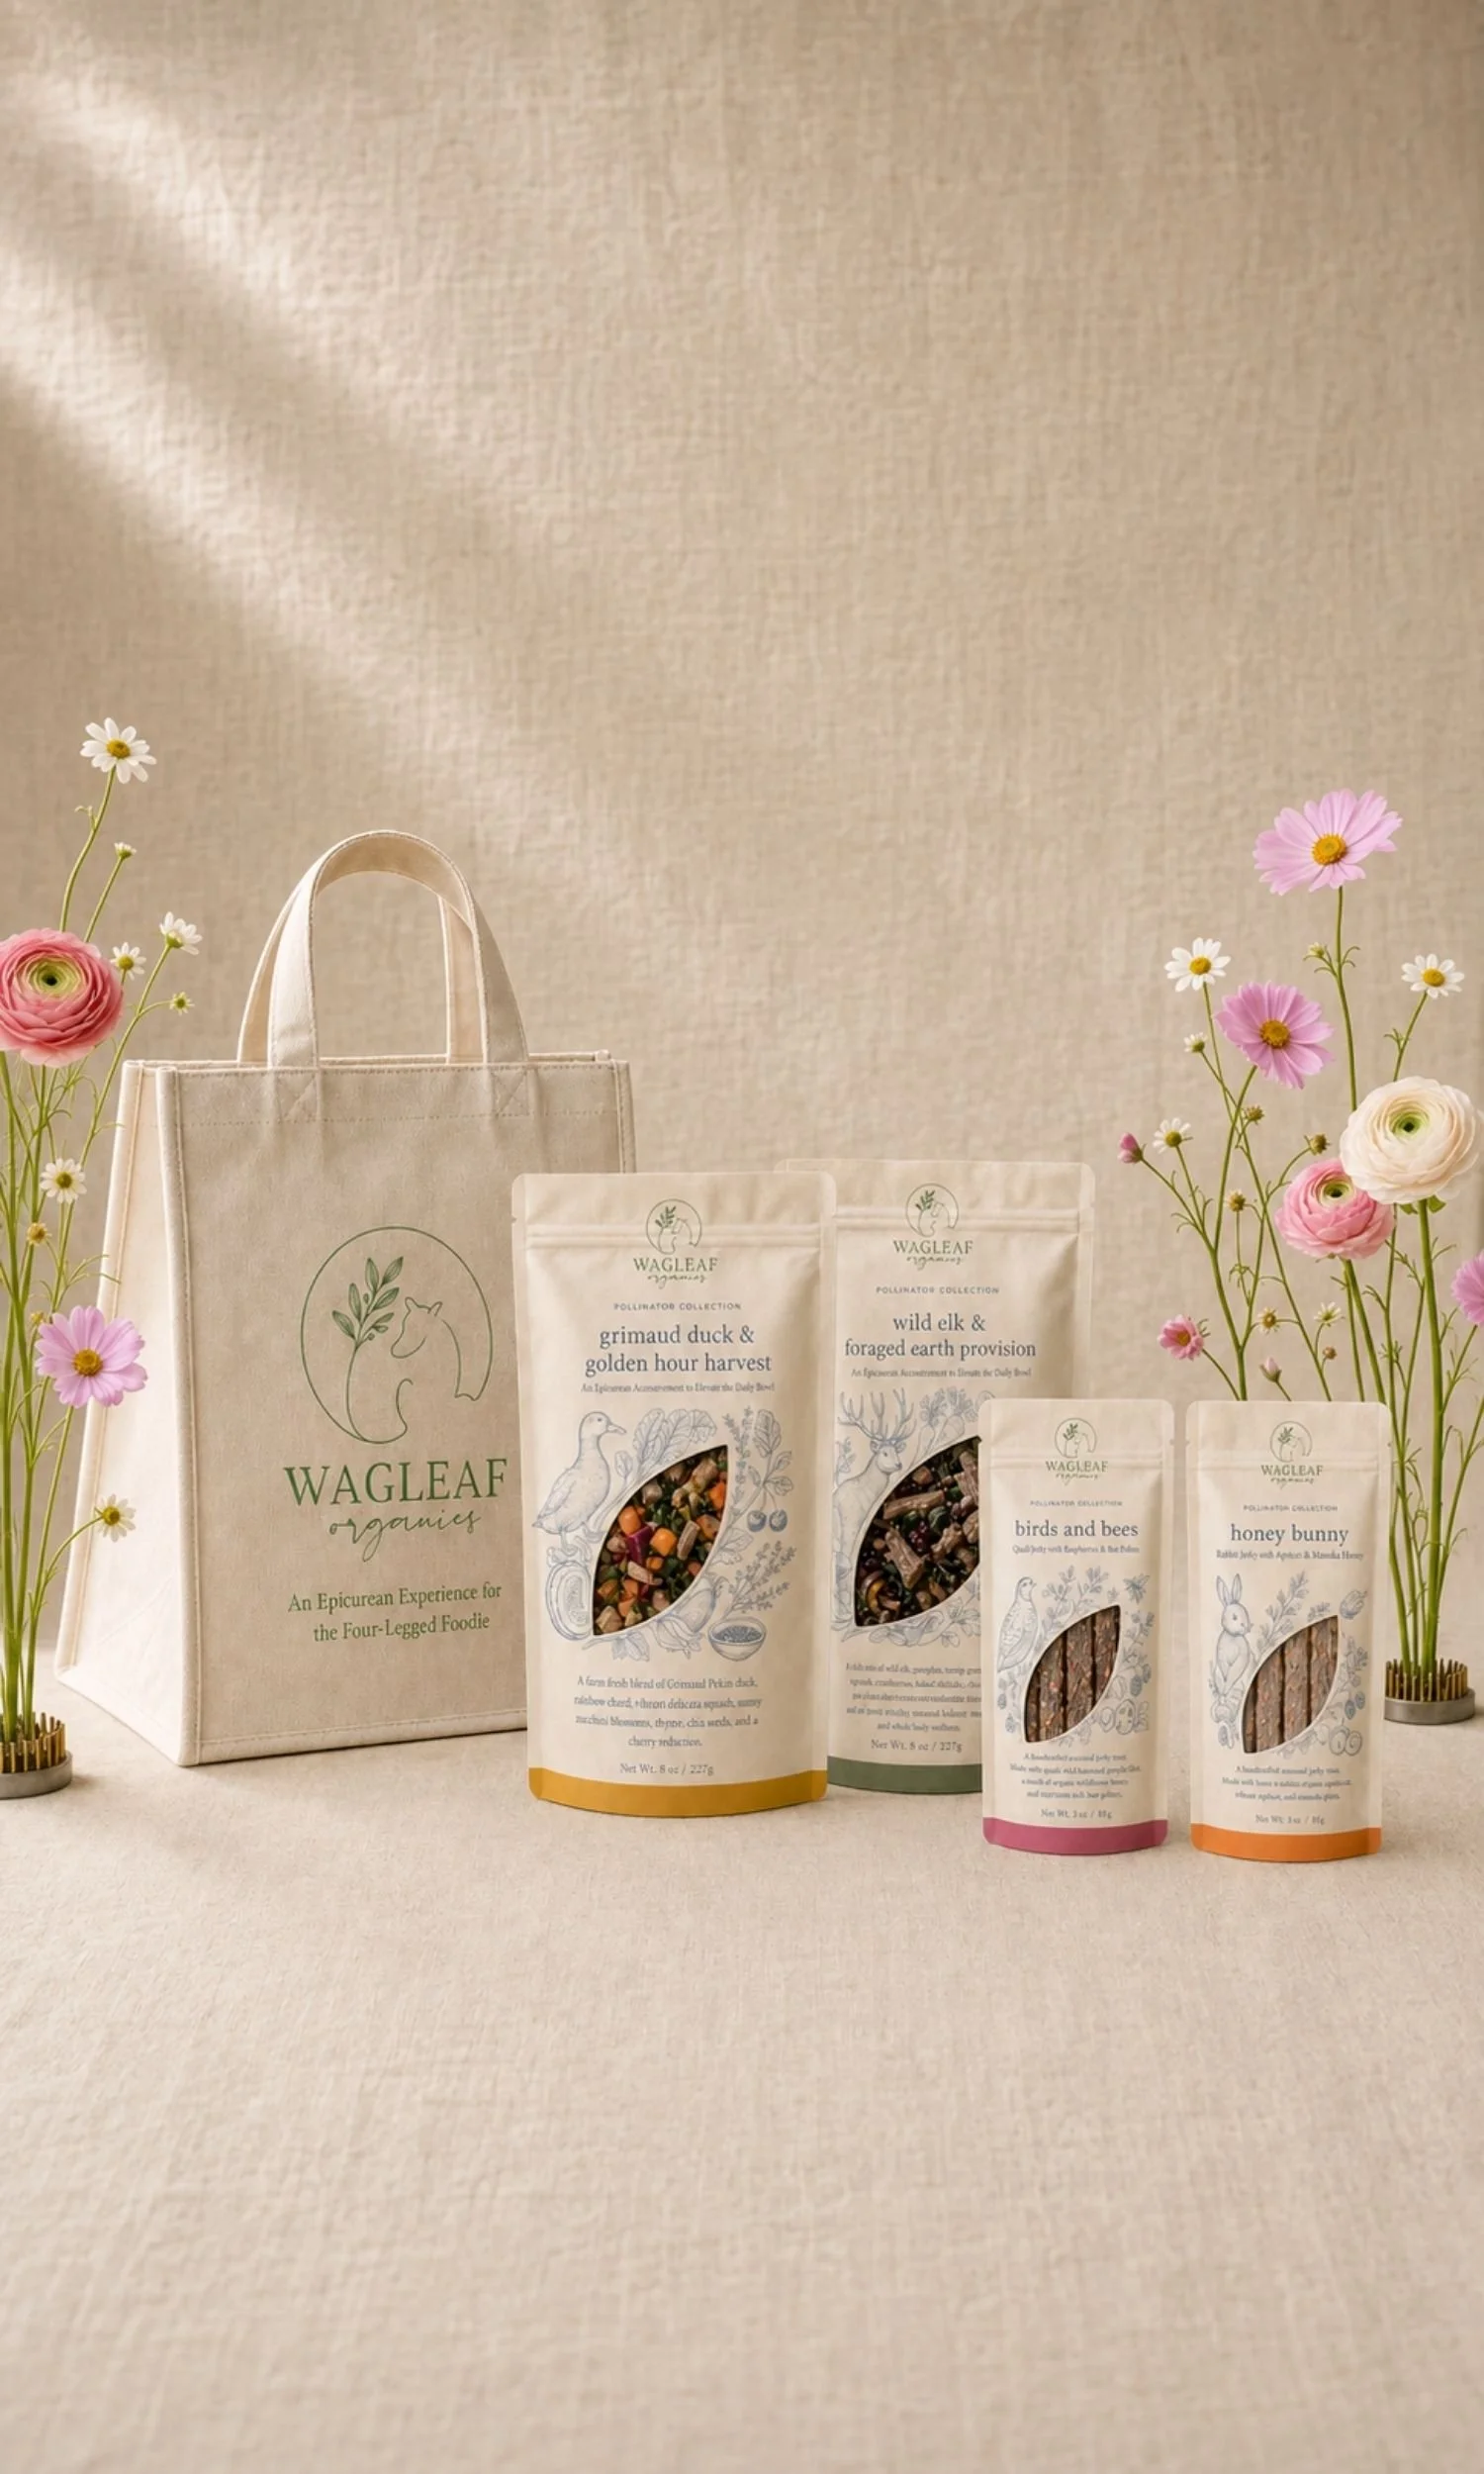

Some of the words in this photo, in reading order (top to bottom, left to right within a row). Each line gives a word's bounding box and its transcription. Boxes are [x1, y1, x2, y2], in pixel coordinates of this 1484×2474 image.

[893, 1241, 974, 1254] WAGLEAF
[633, 1258, 718, 1272] WAGLEAF
[893, 1313, 932, 1331] wild
[938, 1313, 965, 1331] elk
[972, 1314, 986, 1331] &
[600, 1325, 681, 1349] grimaud
[687, 1324, 733, 1344] duck
[739, 1326, 754, 1344] &
[845, 1339, 905, 1360] foraged
[911, 1340, 954, 1356] earth
[960, 1341, 1036, 1361] provision
[585, 1354, 647, 1378] golden
[655, 1354, 698, 1372] hour
[704, 1354, 772, 1372] harvest
[994, 1368, 1011, 1379] Daily
[581, 1383, 594, 1392] An
[735, 1382, 753, 1393] Daily
[1046, 1461, 1108, 1472] WAGLEAF
[1260, 1465, 1324, 1475] WAGLEAF
[283, 1459, 507, 1506] WAGLEAF
[329, 1510, 481, 1562] organics
[1015, 1520, 1058, 1537] birds
[1064, 1520, 1095, 1537] and
[1101, 1521, 1139, 1537] bees
[1231, 1524, 1284, 1546] honey
[1292, 1524, 1348, 1547] bunny
[288, 1594, 312, 1612] An
[318, 1592, 394, 1615] Epicurean
[399, 1585, 478, 1610] Experience
[482, 1581, 502, 1599] for
[314, 1624, 337, 1642] the
[342, 1615, 436, 1640] Four-Legged
[441, 1613, 490, 1632] Foodie
[578, 1676, 585, 1685] A
[655, 1678, 666, 1689] of
[734, 1715, 751, 1726] and
[871, 1739, 887, 1749] Net
[889, 1740, 907, 1750] Wt.
[940, 1742, 962, 1753] 227g
[619, 1763, 637, 1773] Net
[639, 1763, 657, 1773] Wt.
[659, 1763, 665, 1773] 8
[668, 1765, 679, 1774] oz
[682, 1763, 686, 1775] /
[691, 1763, 713, 1776] 227g
